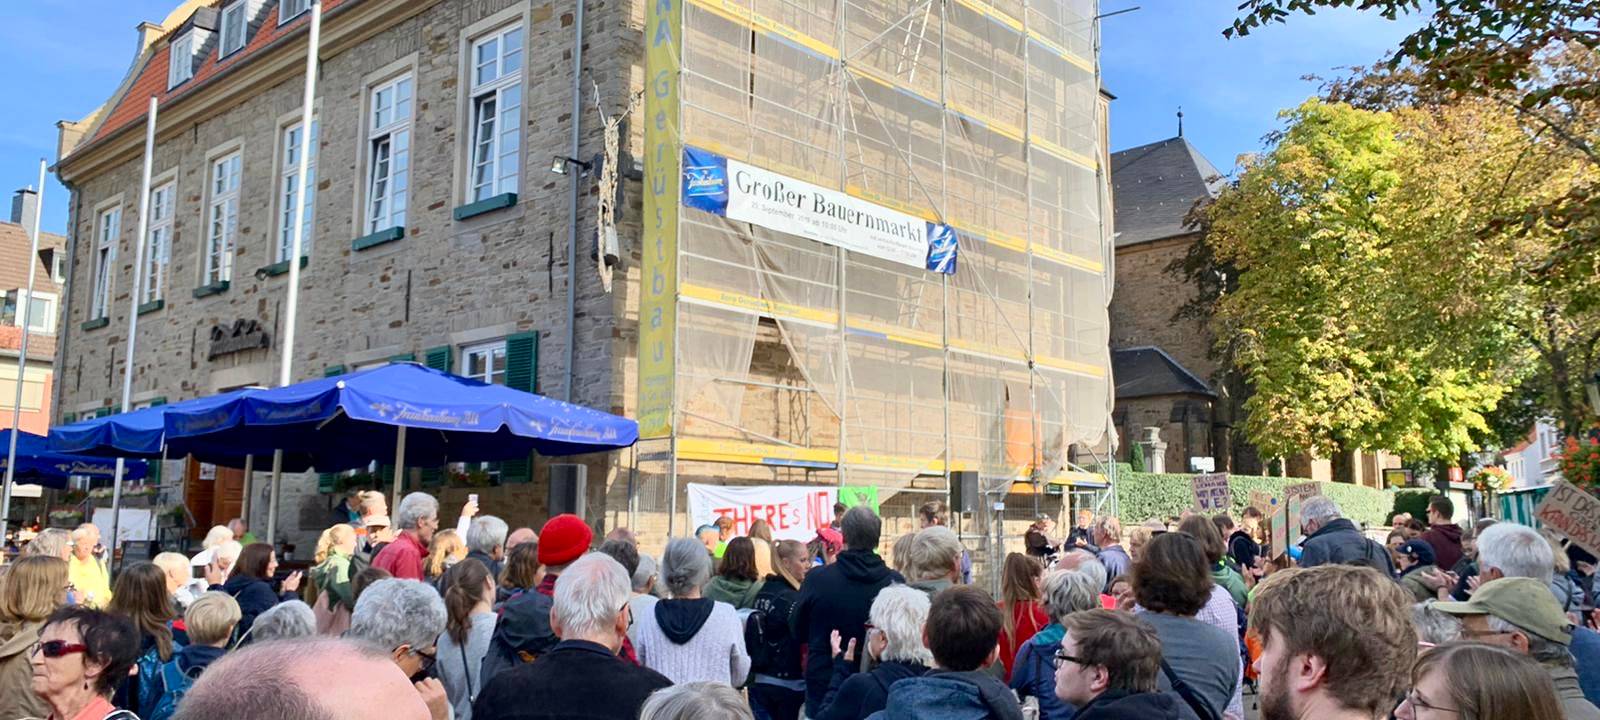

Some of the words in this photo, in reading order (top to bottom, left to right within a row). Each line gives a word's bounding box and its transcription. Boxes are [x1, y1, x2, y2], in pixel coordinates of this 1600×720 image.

[736, 169, 807, 209] Großer
[813, 192, 922, 243] Bauernmarkt
[1284, 483, 1317, 496] SYSTEM
[1552, 484, 1578, 504] IST
[807, 491, 830, 531] NO
